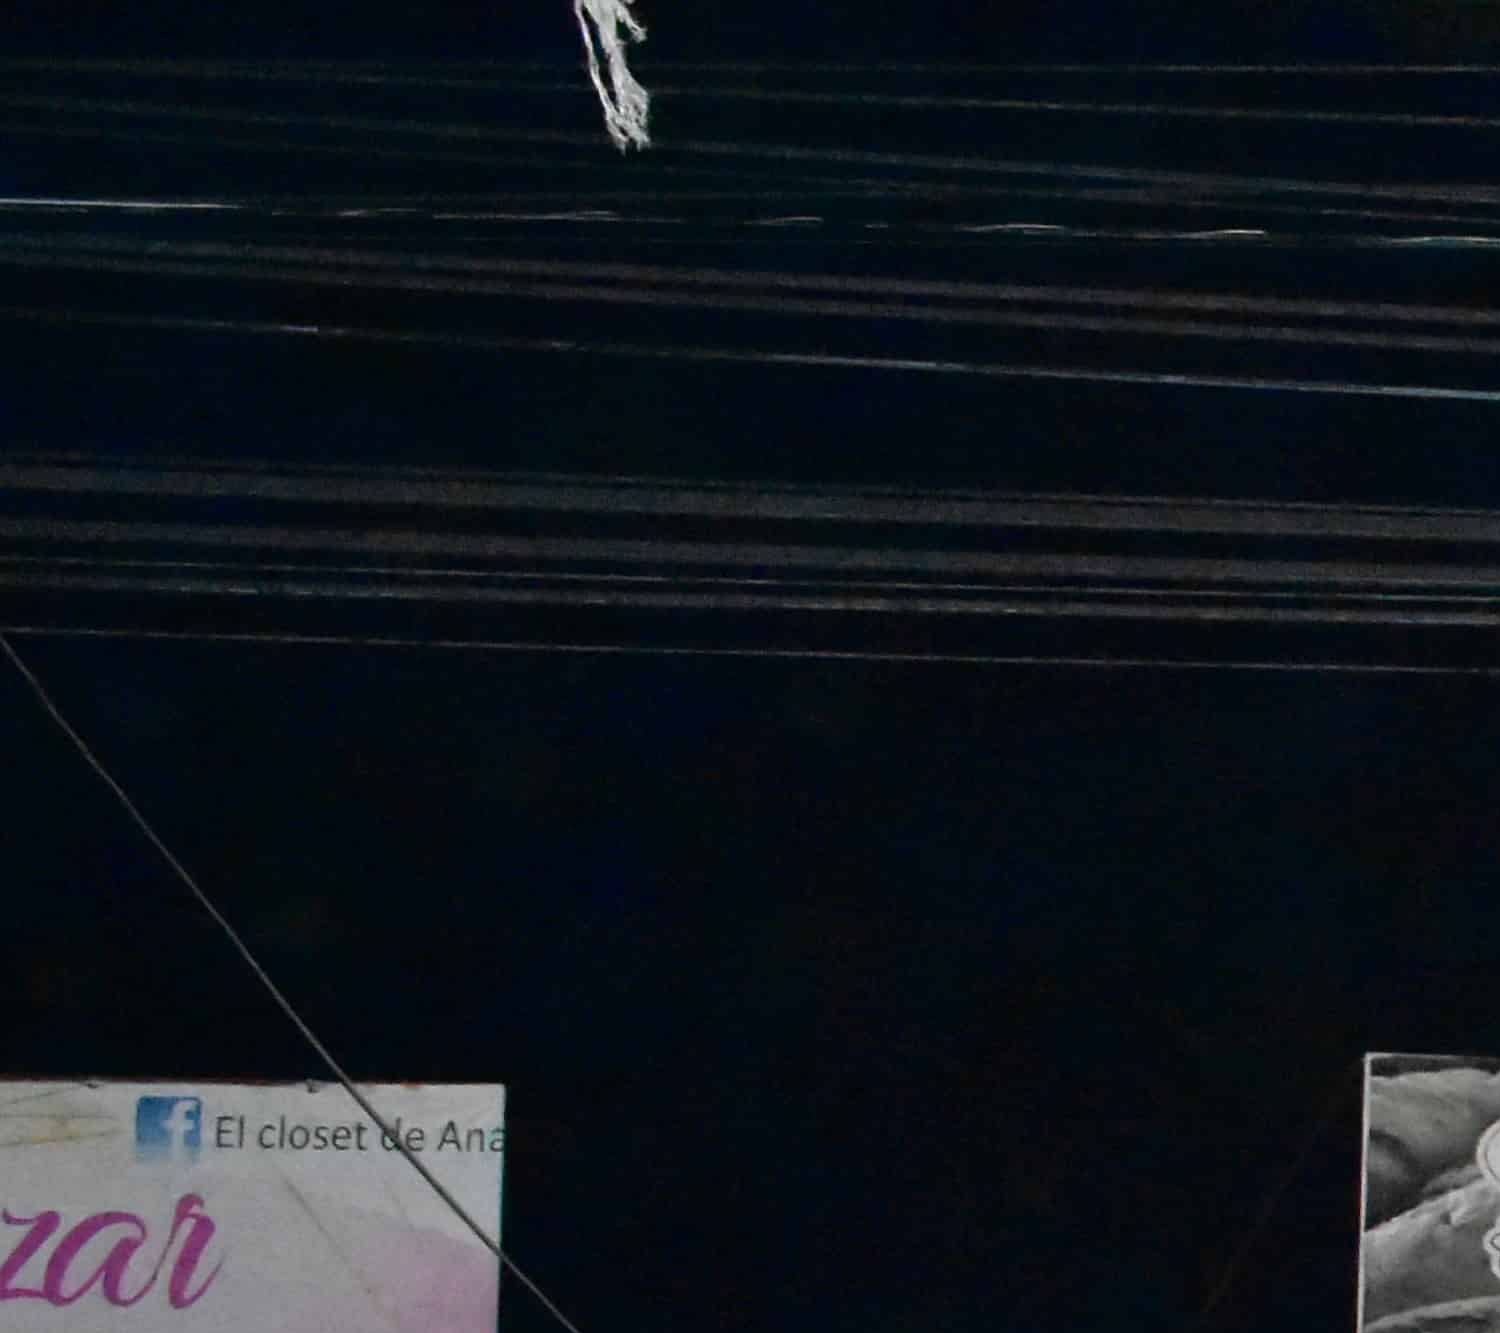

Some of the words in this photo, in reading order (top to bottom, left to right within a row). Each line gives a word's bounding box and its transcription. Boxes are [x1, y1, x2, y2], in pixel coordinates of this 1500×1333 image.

[215, 1115, 246, 1150] El
[257, 1116, 368, 1152] closet
[381, 1117, 425, 1152] de
